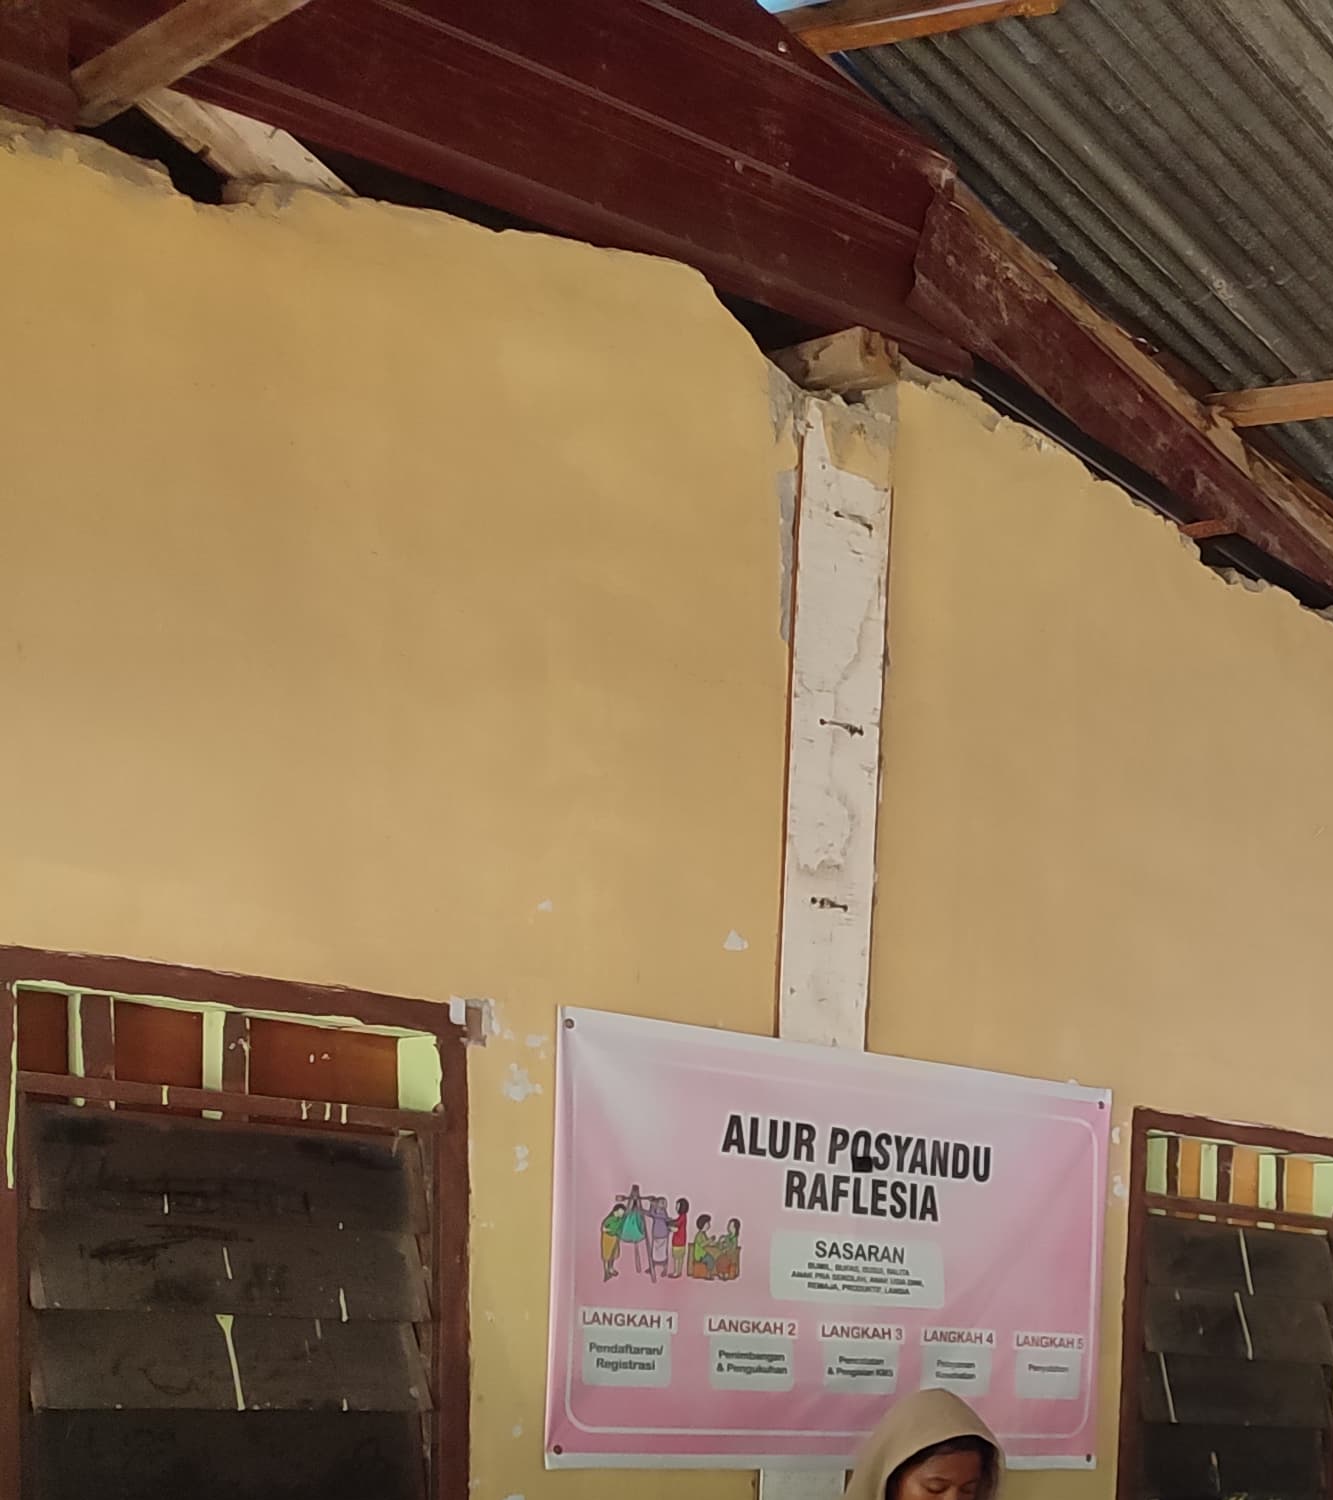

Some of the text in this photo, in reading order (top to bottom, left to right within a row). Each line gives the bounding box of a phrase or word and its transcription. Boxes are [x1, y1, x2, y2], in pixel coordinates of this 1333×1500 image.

[721, 1114, 991, 1182] ALUR POSYANDU
[785, 1170, 939, 1222] RAFLESIA
[815, 1240, 904, 1264] SASARAN
[582, 1311, 673, 1329] LANGKAH 1
[708, 1318, 796, 1335] LANGKAH 2
[821, 1324, 903, 1341] LANGKAH 3
[923, 1330, 994, 1344] LANGKAH 4
[1016, 1334, 1084, 1349] LANGKAH 5
[596, 1358, 655, 1371] Registrasi
[716, 1363, 724, 1372] &
